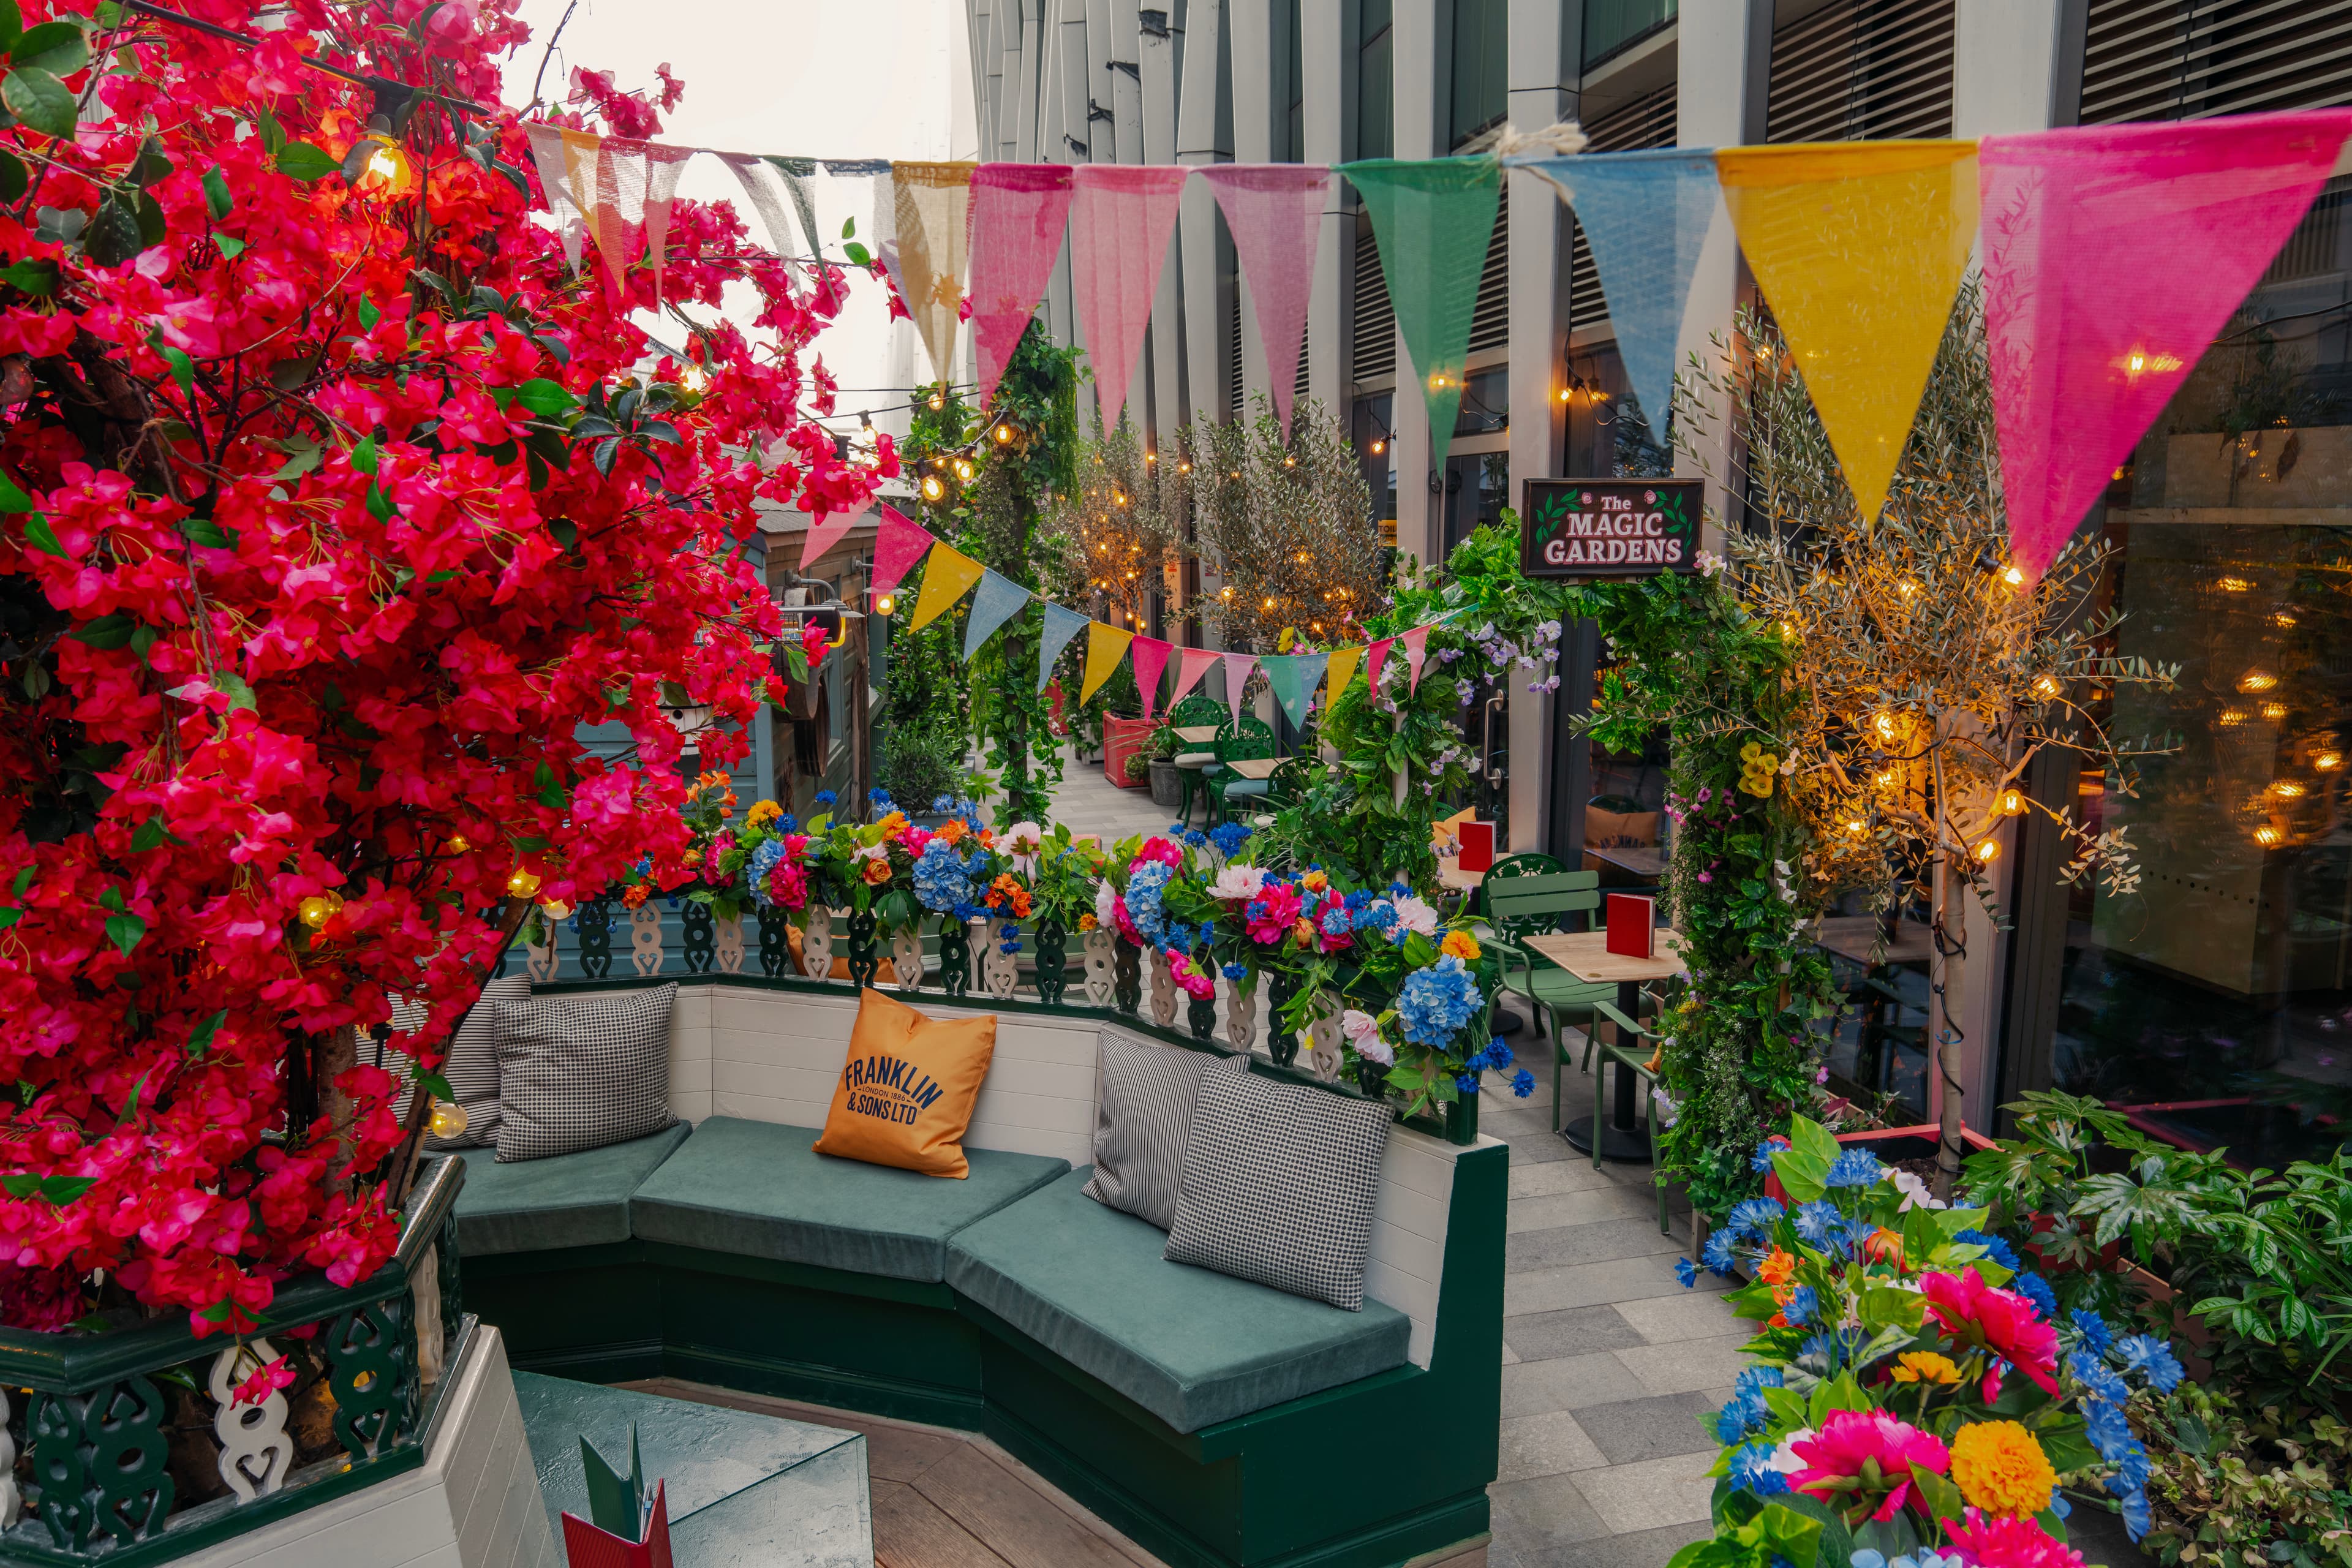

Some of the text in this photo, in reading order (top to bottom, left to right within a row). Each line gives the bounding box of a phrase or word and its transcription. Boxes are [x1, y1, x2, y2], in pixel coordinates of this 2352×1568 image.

[1600, 496, 1632, 511] The
[1566, 513, 1663, 538] MAGIC
[1545, 539, 1682, 565] GARDENS
[845, 1056, 944, 1110] FRANKLIN
[862, 1085, 906, 1101] LONDON 1886
[846, 1091, 918, 1125] & SONS LTD
